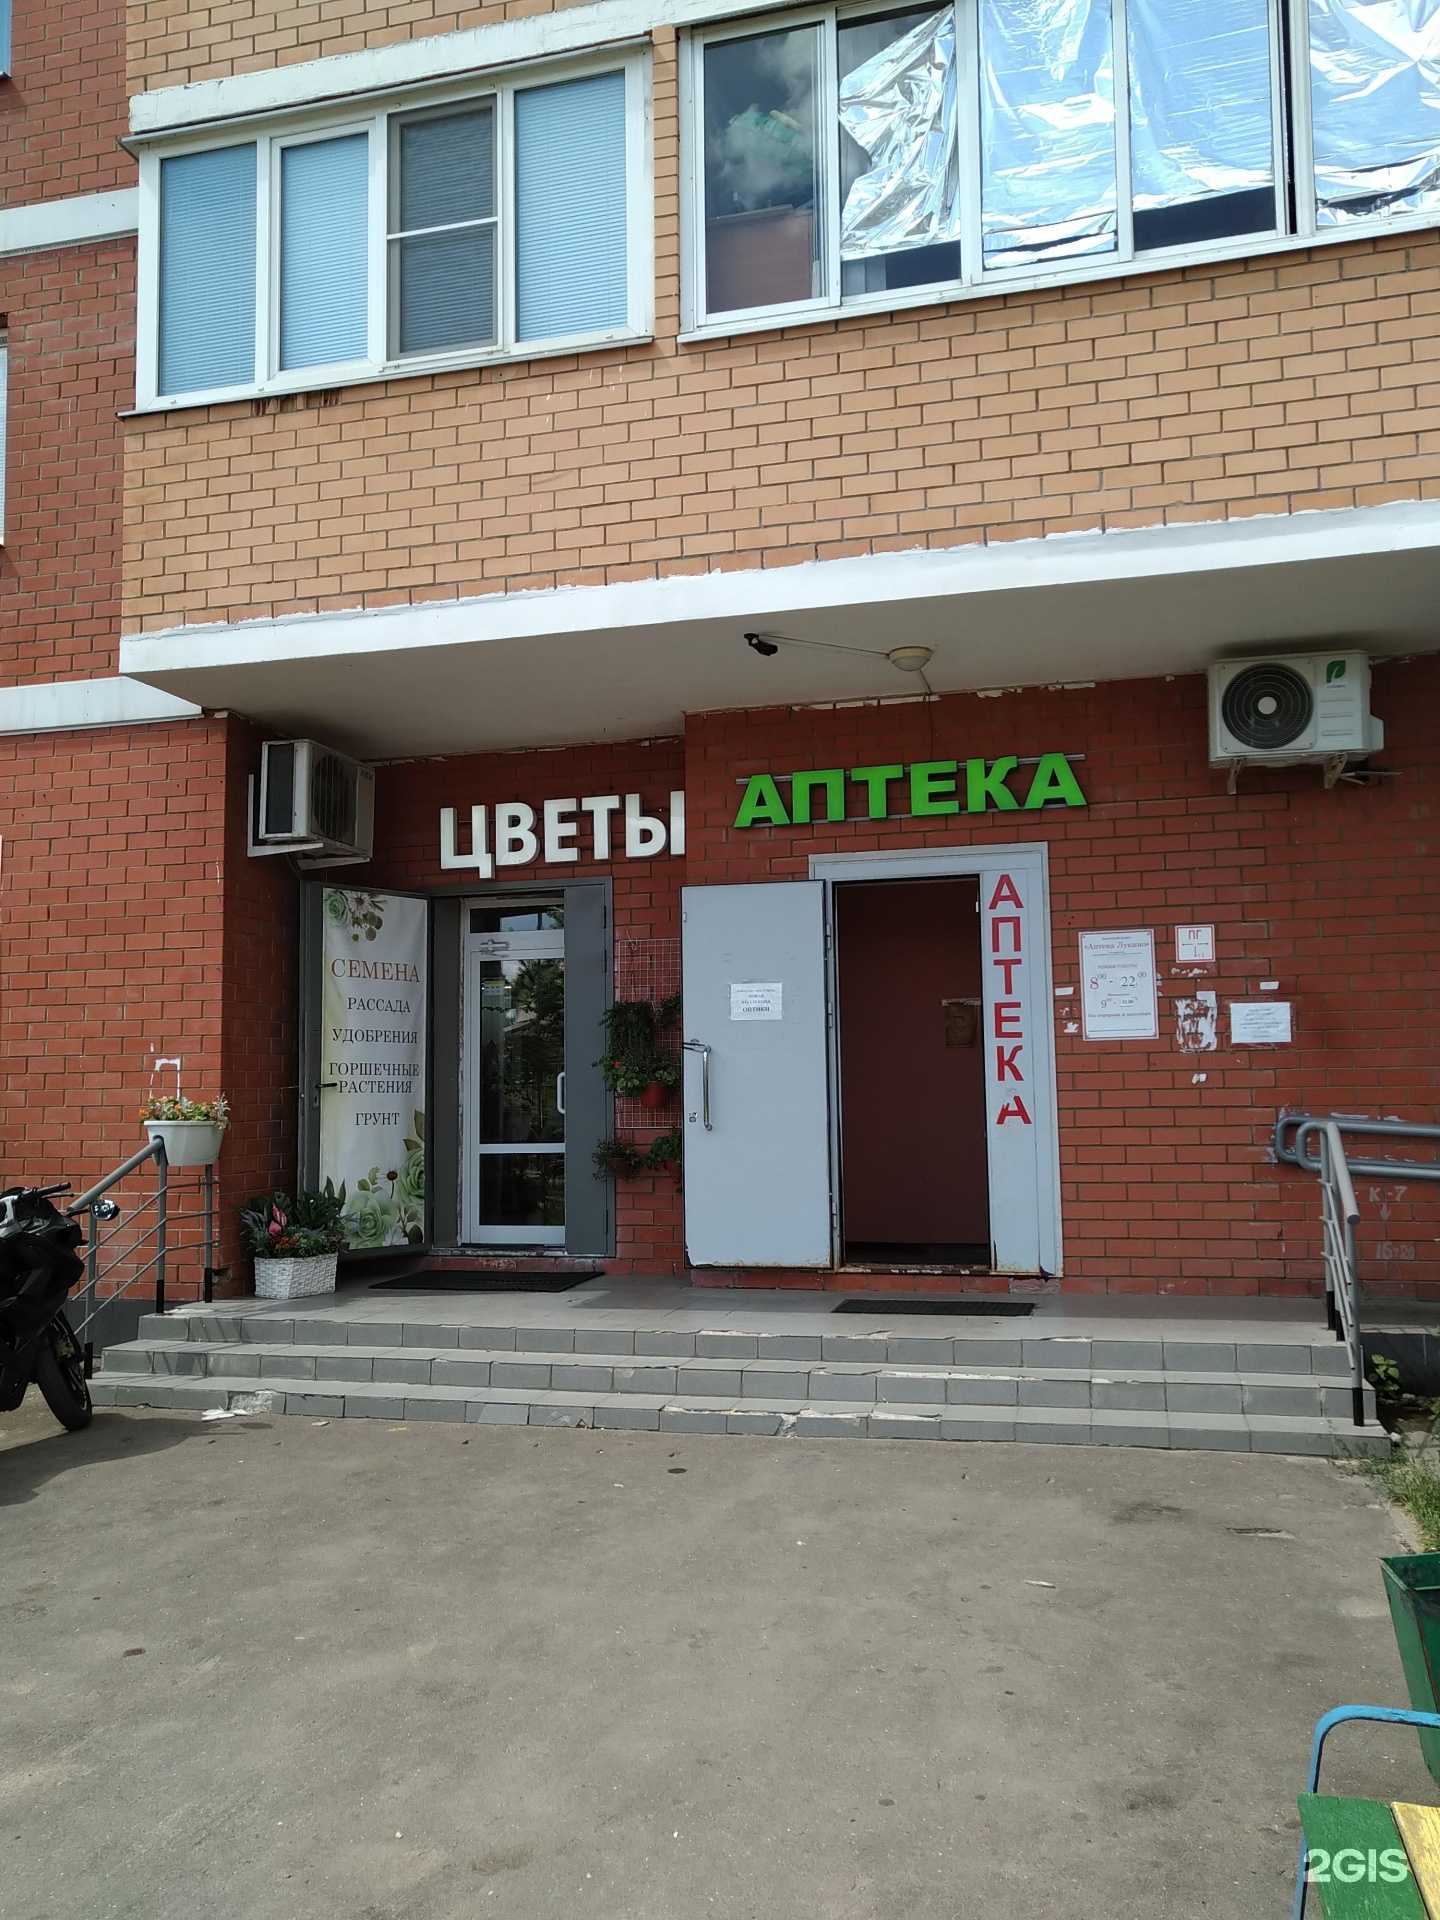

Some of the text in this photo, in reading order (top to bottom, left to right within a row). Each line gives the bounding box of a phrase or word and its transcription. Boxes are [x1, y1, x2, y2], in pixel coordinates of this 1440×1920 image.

[734, 753, 1087, 829] АПТЕКА
[440, 790, 686, 880] ЦВЕТЫ
[331, 959, 420, 982] СЕМЕНА
[347, 997, 411, 1013] РАССАДА
[988, 873, 1033, 1125] АПТЕКА
[332, 1028, 418, 1044] УДОБРЕНИЯ
[329, 1062, 420, 1077] ГОРШЕЧНЫЕ
[339, 1080, 413, 1094] РАСТЕНИЯ
[355, 1112, 400, 1126] ГРУНТ
